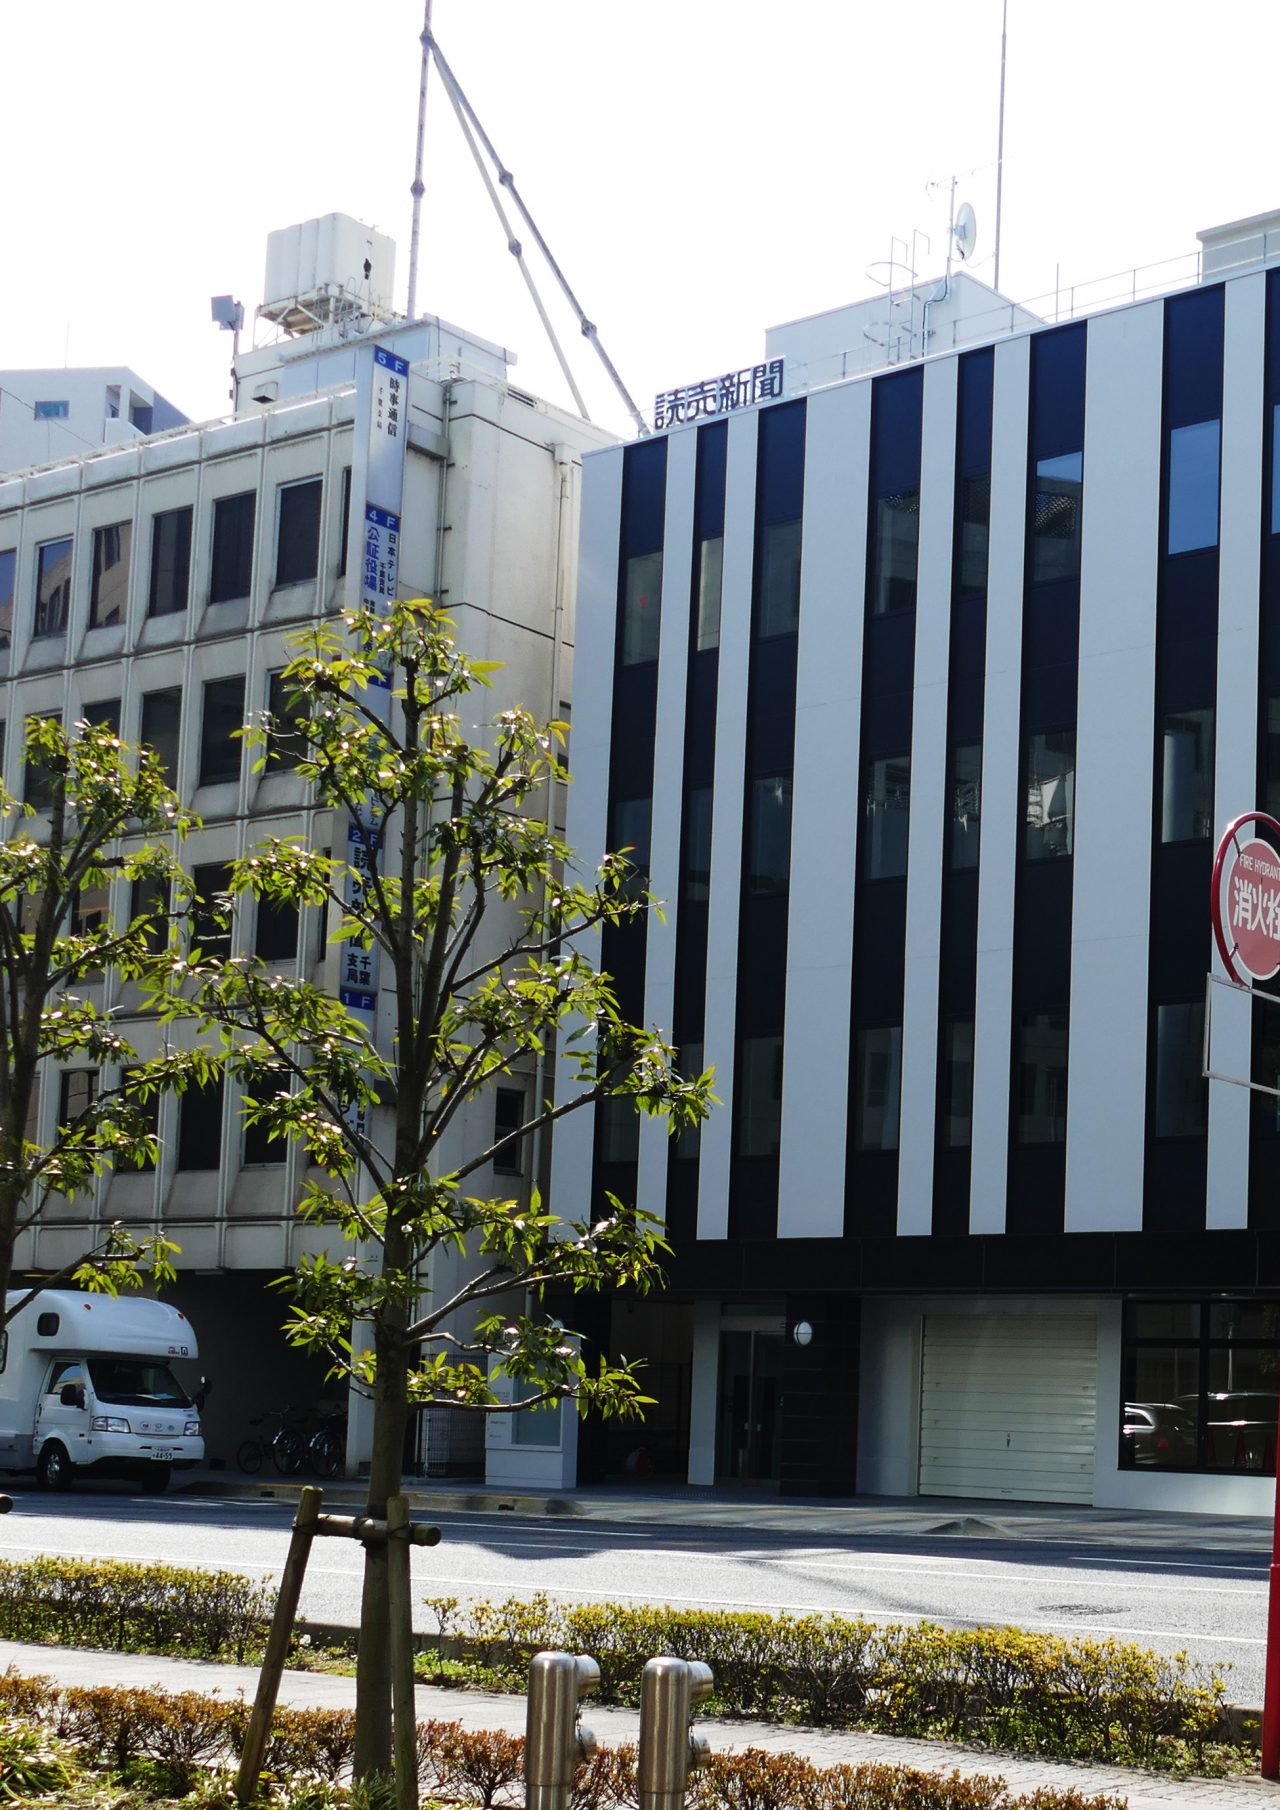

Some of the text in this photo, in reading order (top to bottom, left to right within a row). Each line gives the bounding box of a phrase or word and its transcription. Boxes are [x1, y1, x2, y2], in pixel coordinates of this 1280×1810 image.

[388, 376, 400, 437] 時事通信
[655, 359, 784, 430] 読売新聞
[387, 532, 397, 597] 日本テレビ
[1240, 853, 1280, 881] FIRE HYDRANT
[346, 953, 359, 984] 支局
